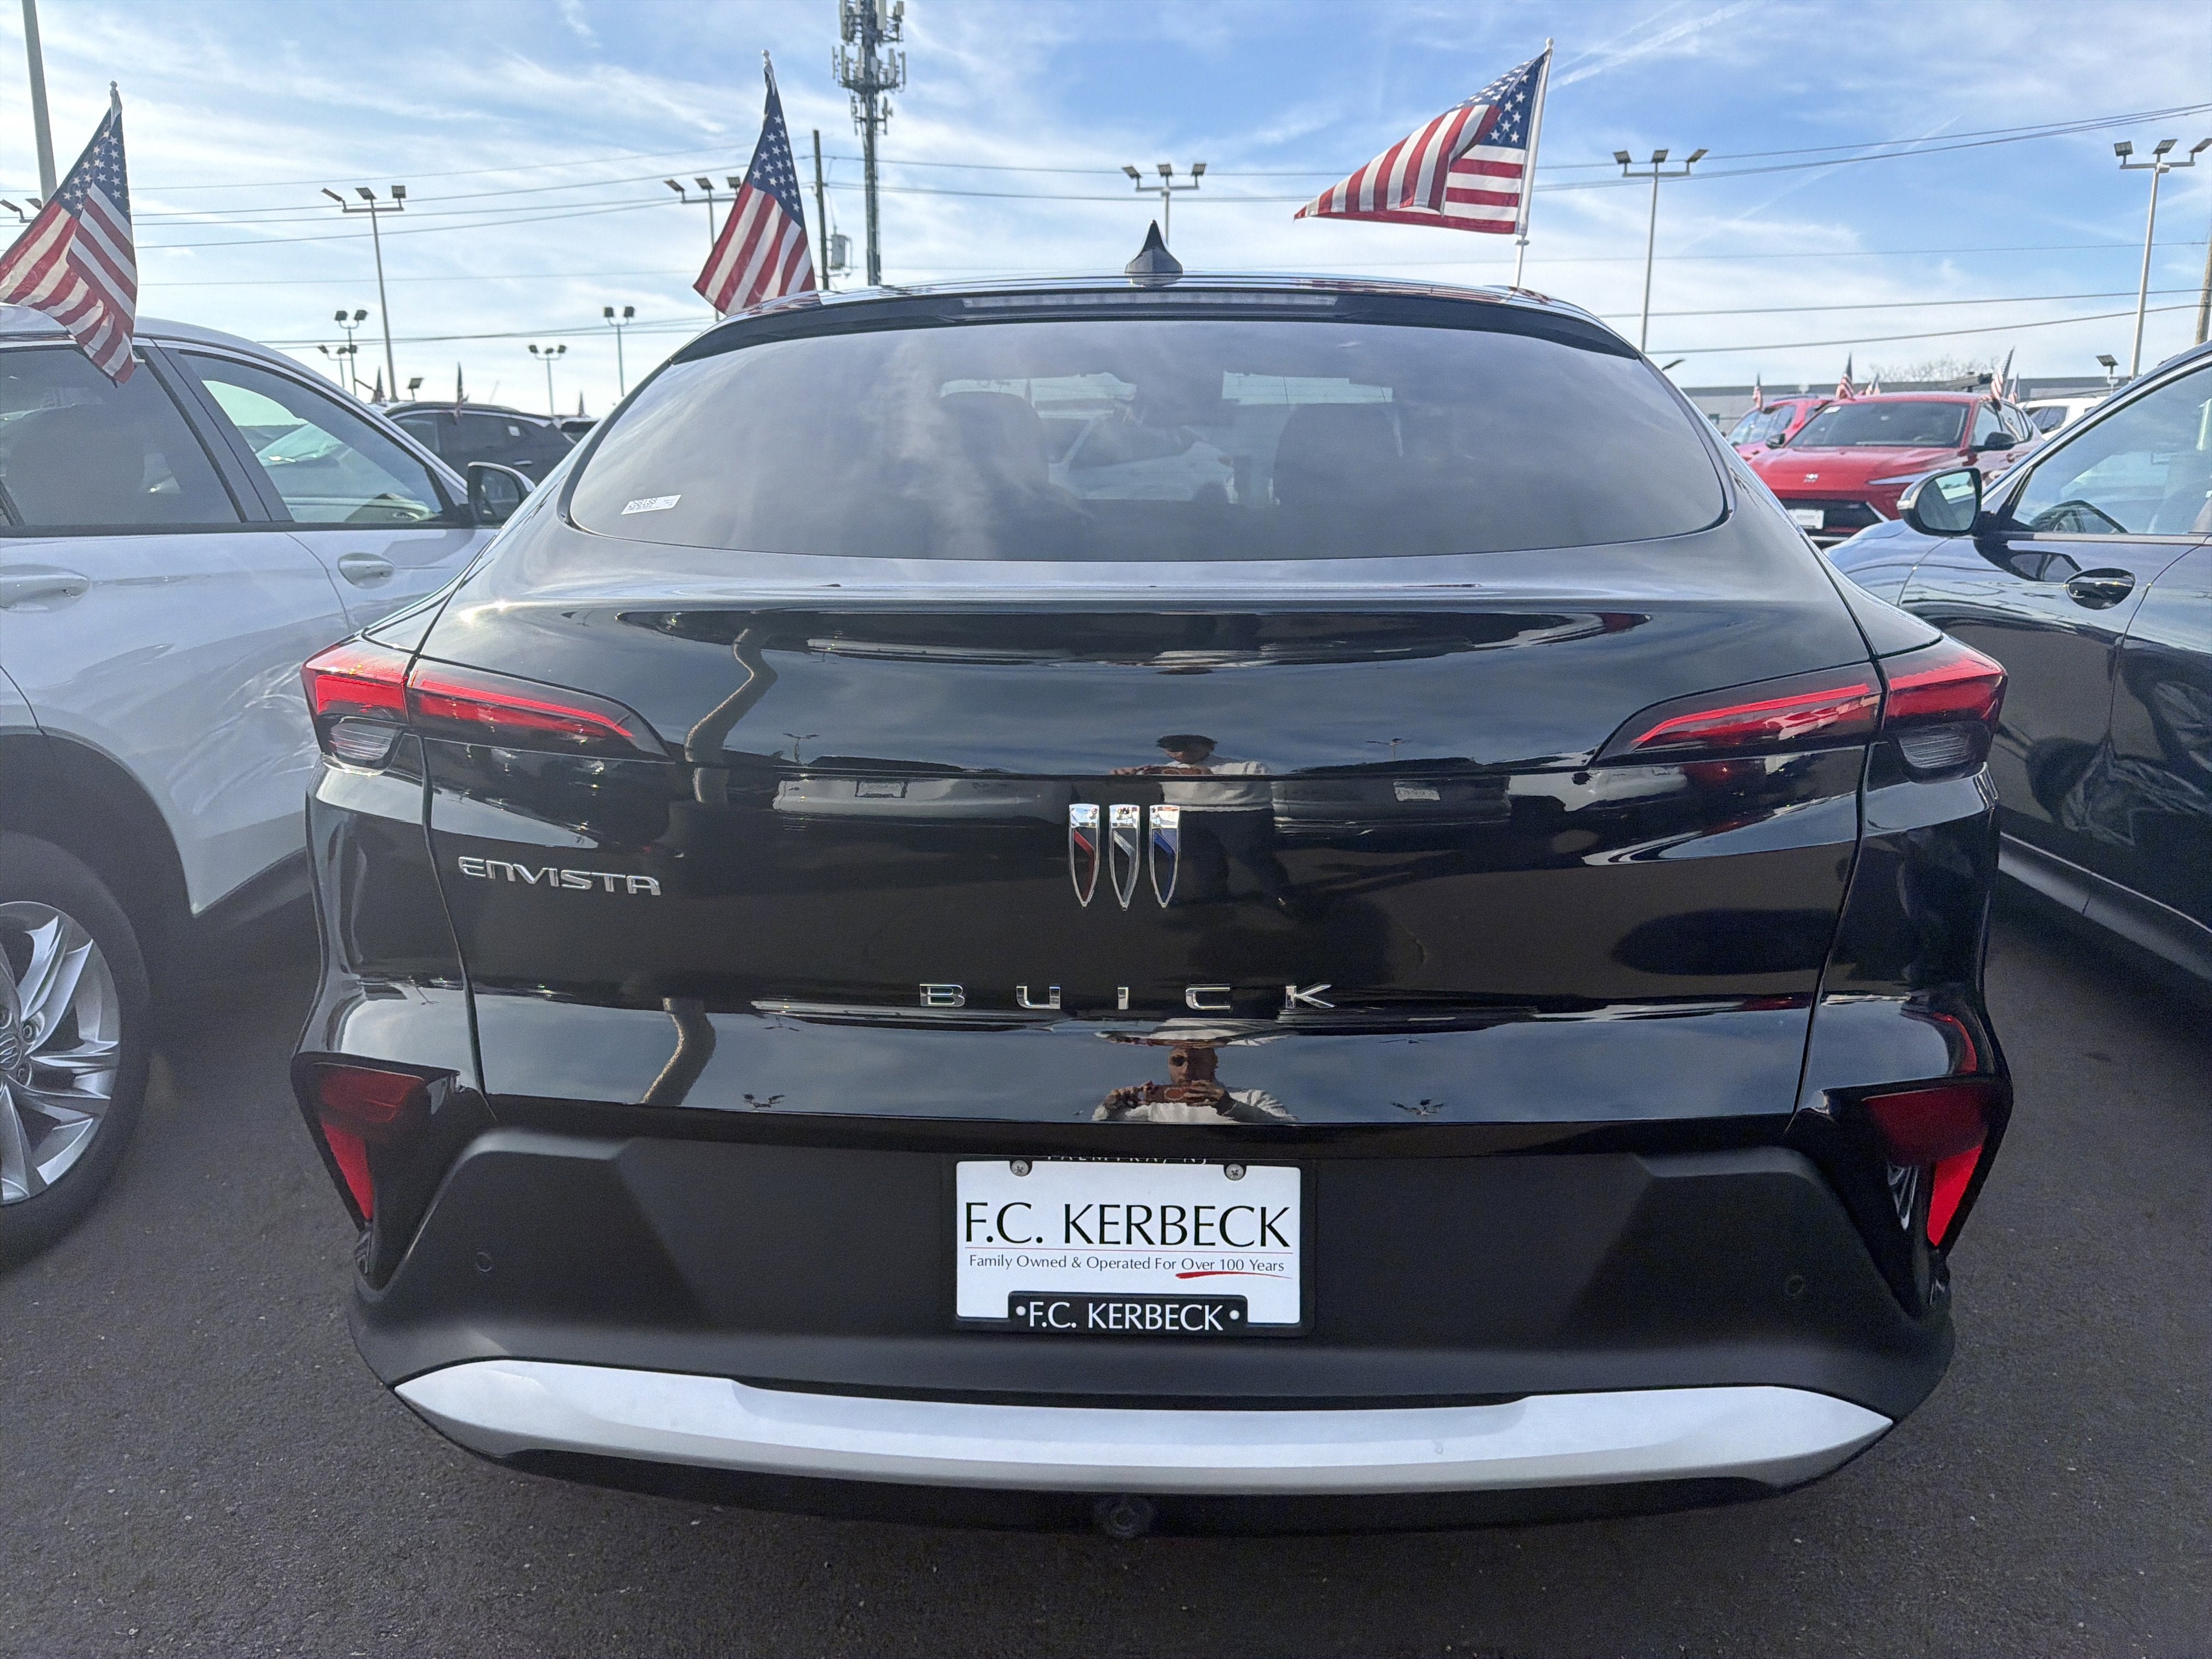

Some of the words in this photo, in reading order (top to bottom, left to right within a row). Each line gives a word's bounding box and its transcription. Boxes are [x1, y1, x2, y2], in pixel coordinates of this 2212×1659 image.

[458, 856, 662, 896] ENVISTA
[919, 984, 1335, 1011] BUICK
[966, 1202, 1043, 1244] F.C.
[1064, 1204, 1291, 1248] KERBECK
[969, 1254, 1013, 1269] Family
[1017, 1255, 1066, 1268] Owned
[1071, 1256, 1081, 1268] &
[1086, 1256, 1150, 1272] Operated
[1155, 1257, 1176, 1270] For
[1181, 1258, 1215, 1271] Over
[1220, 1259, 1244, 1271] 100
[1249, 1259, 1284, 1272] Years
[1029, 1301, 1077, 1329] F.C.
[1088, 1302, 1224, 1331] KERBECK
